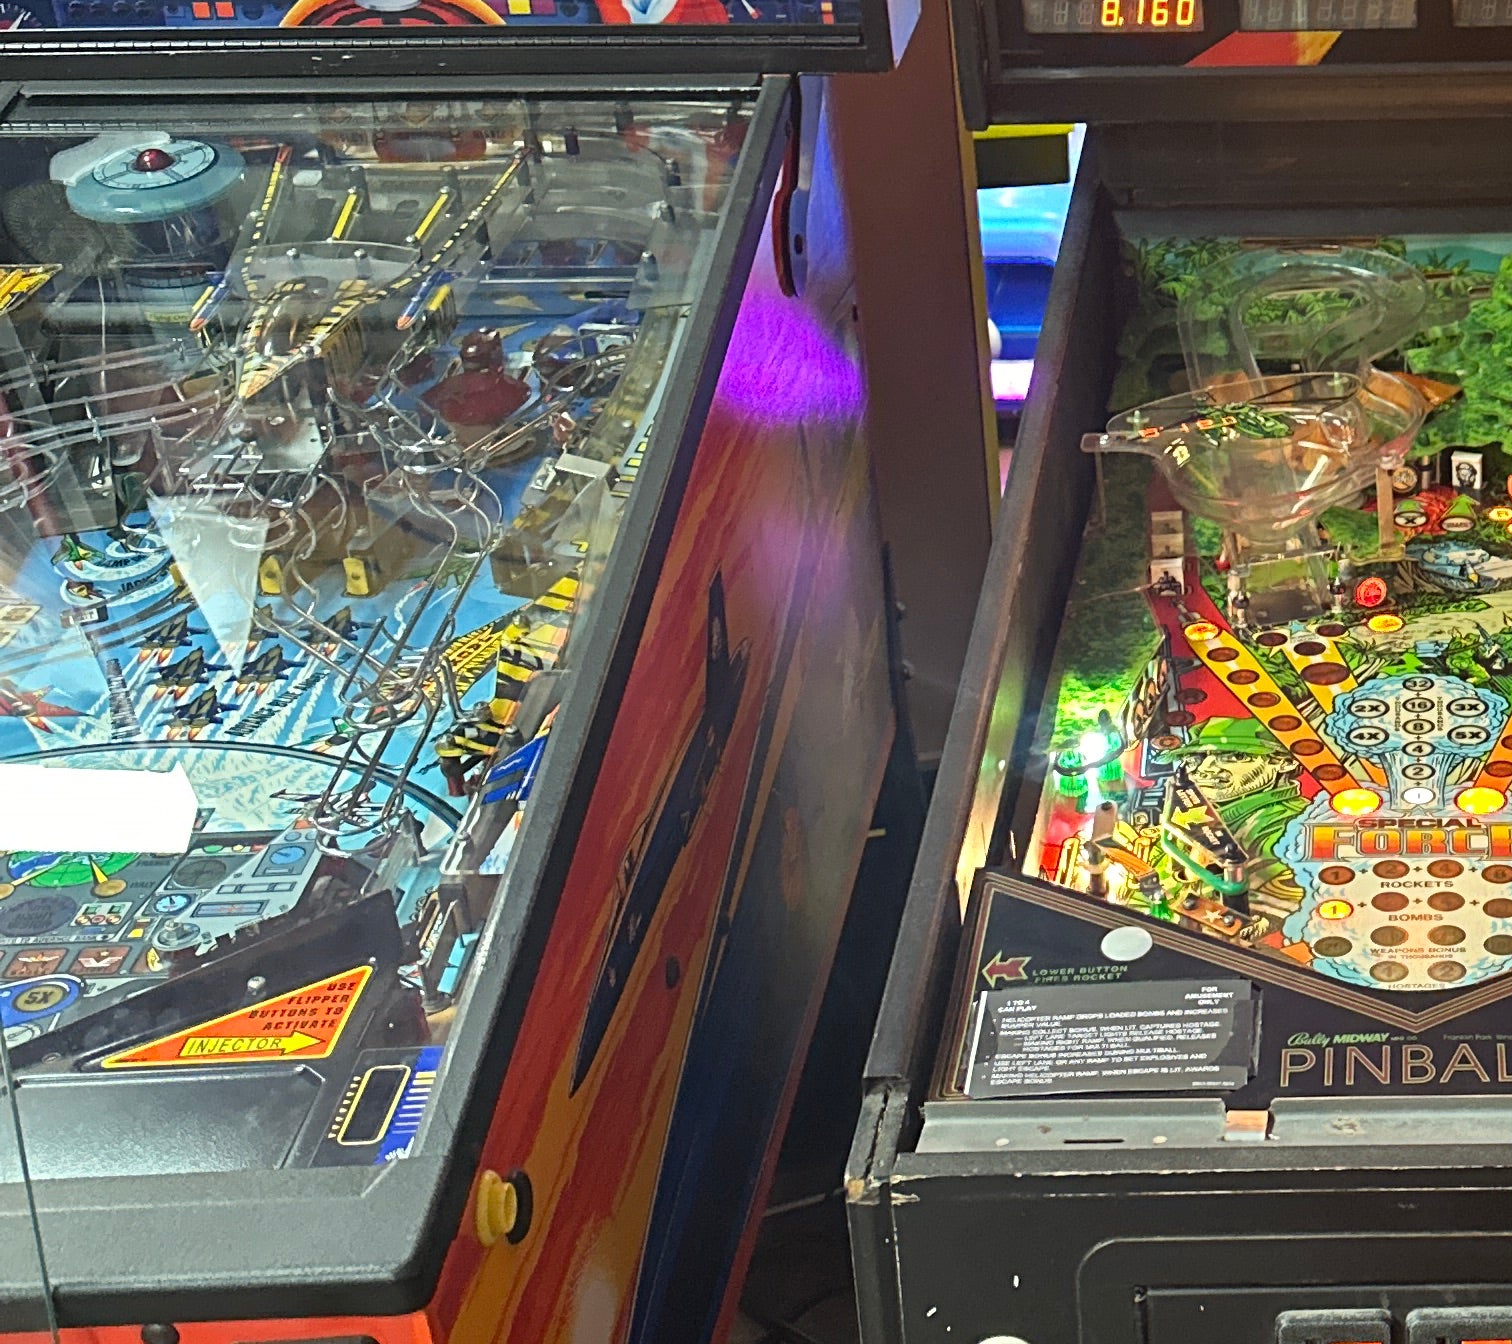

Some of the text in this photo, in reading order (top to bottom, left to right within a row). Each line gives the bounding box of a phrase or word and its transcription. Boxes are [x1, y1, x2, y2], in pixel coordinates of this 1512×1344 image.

[1408, 680, 1428, 688] 32
[1353, 704, 1380, 713] 2X
[1409, 701, 1428, 709] 16
[1454, 703, 1481, 712] 3X
[1412, 722, 1424, 731] 8
[1352, 732, 1379, 740] 4X
[1454, 731, 1481, 740] 5X
[1412, 744, 1424, 753] 4
[1412, 767, 1424, 776] 2
[1358, 818, 1482, 828] SPECIAL
[1380, 880, 1454, 888] ROCKETS
[1388, 913, 1444, 922] BOMBS
[1428, 946, 1467, 954] BONUS
[1032, 965, 1128, 976] LOWER BUTTON
[1034, 973, 1123, 983] FIRES ROCKET
[326, 982, 356, 992] USE
[24, 991, 54, 1005] 5X
[287, 994, 350, 1005] FLIPPER
[249, 1007, 344, 1019] BUTTONS TO
[262, 1019, 338, 1031] ACTIVATE
[1287, 1031, 1390, 1047] Bally MIDWAY
[187, 1039, 283, 1054] INJECTOR
